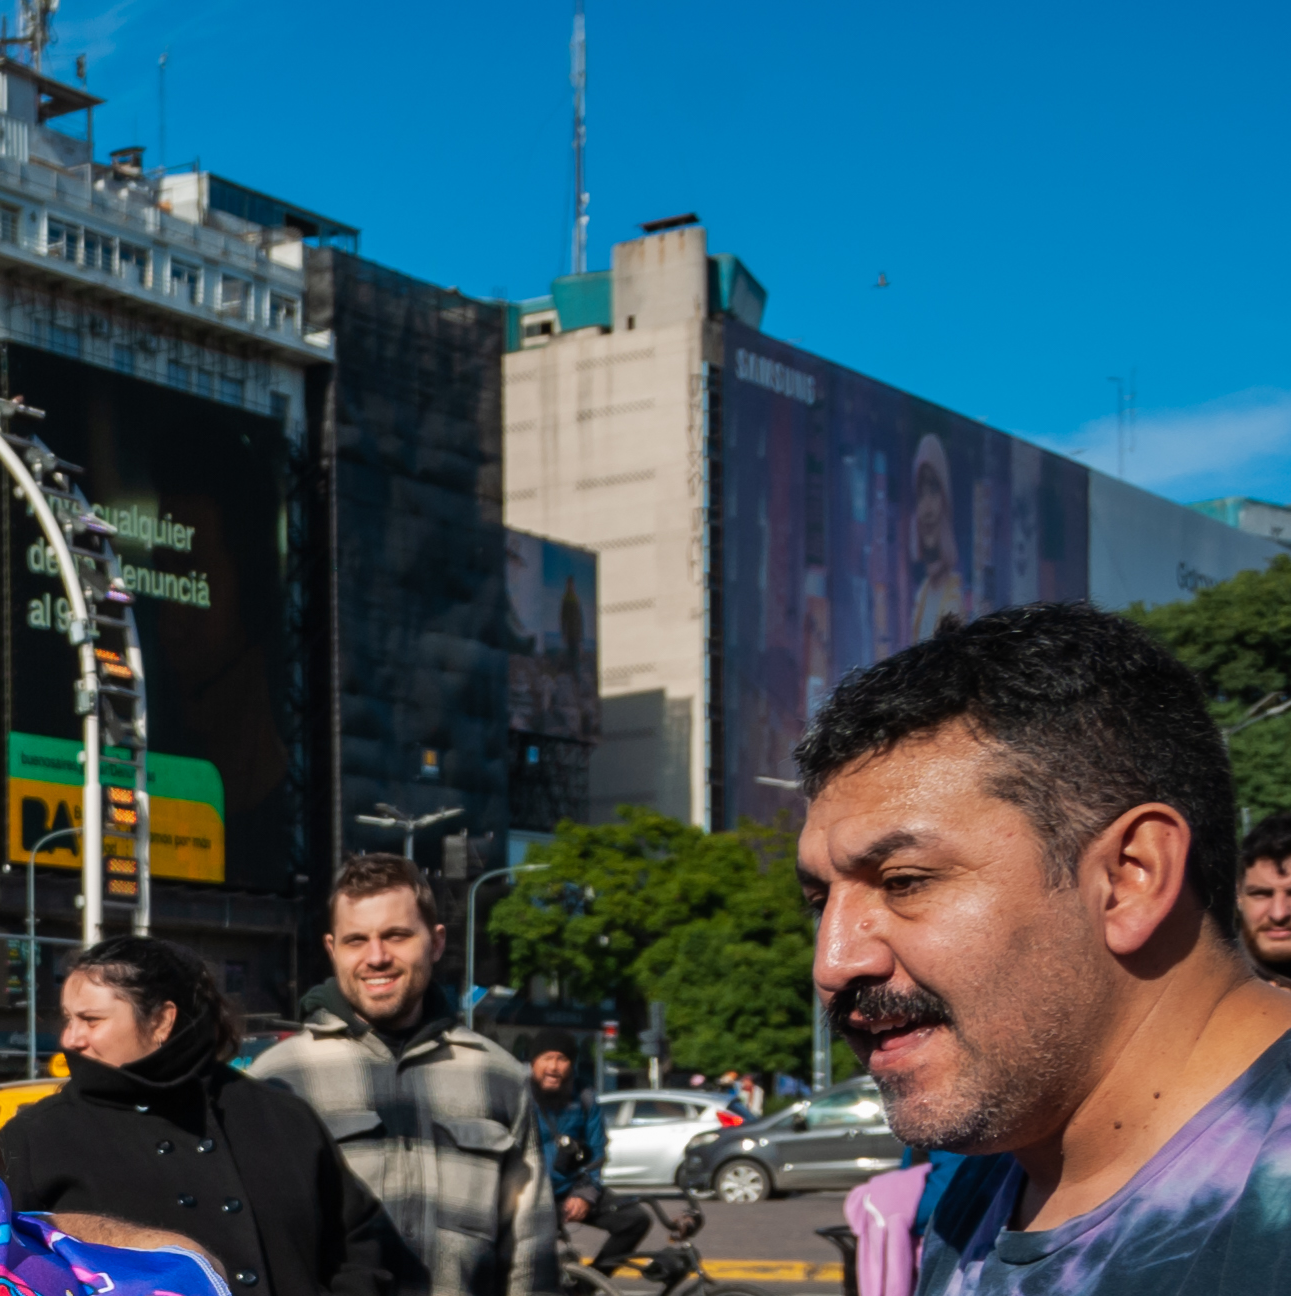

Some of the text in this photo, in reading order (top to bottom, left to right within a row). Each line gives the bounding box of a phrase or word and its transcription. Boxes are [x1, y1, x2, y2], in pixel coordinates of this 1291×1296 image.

[736, 348, 816, 405] SAMSUNG
[118, 554, 210, 608] enunciá
[27, 593, 100, 638] al 91
[22, 796, 78, 857] BA
[150, 831, 173, 846] amos
